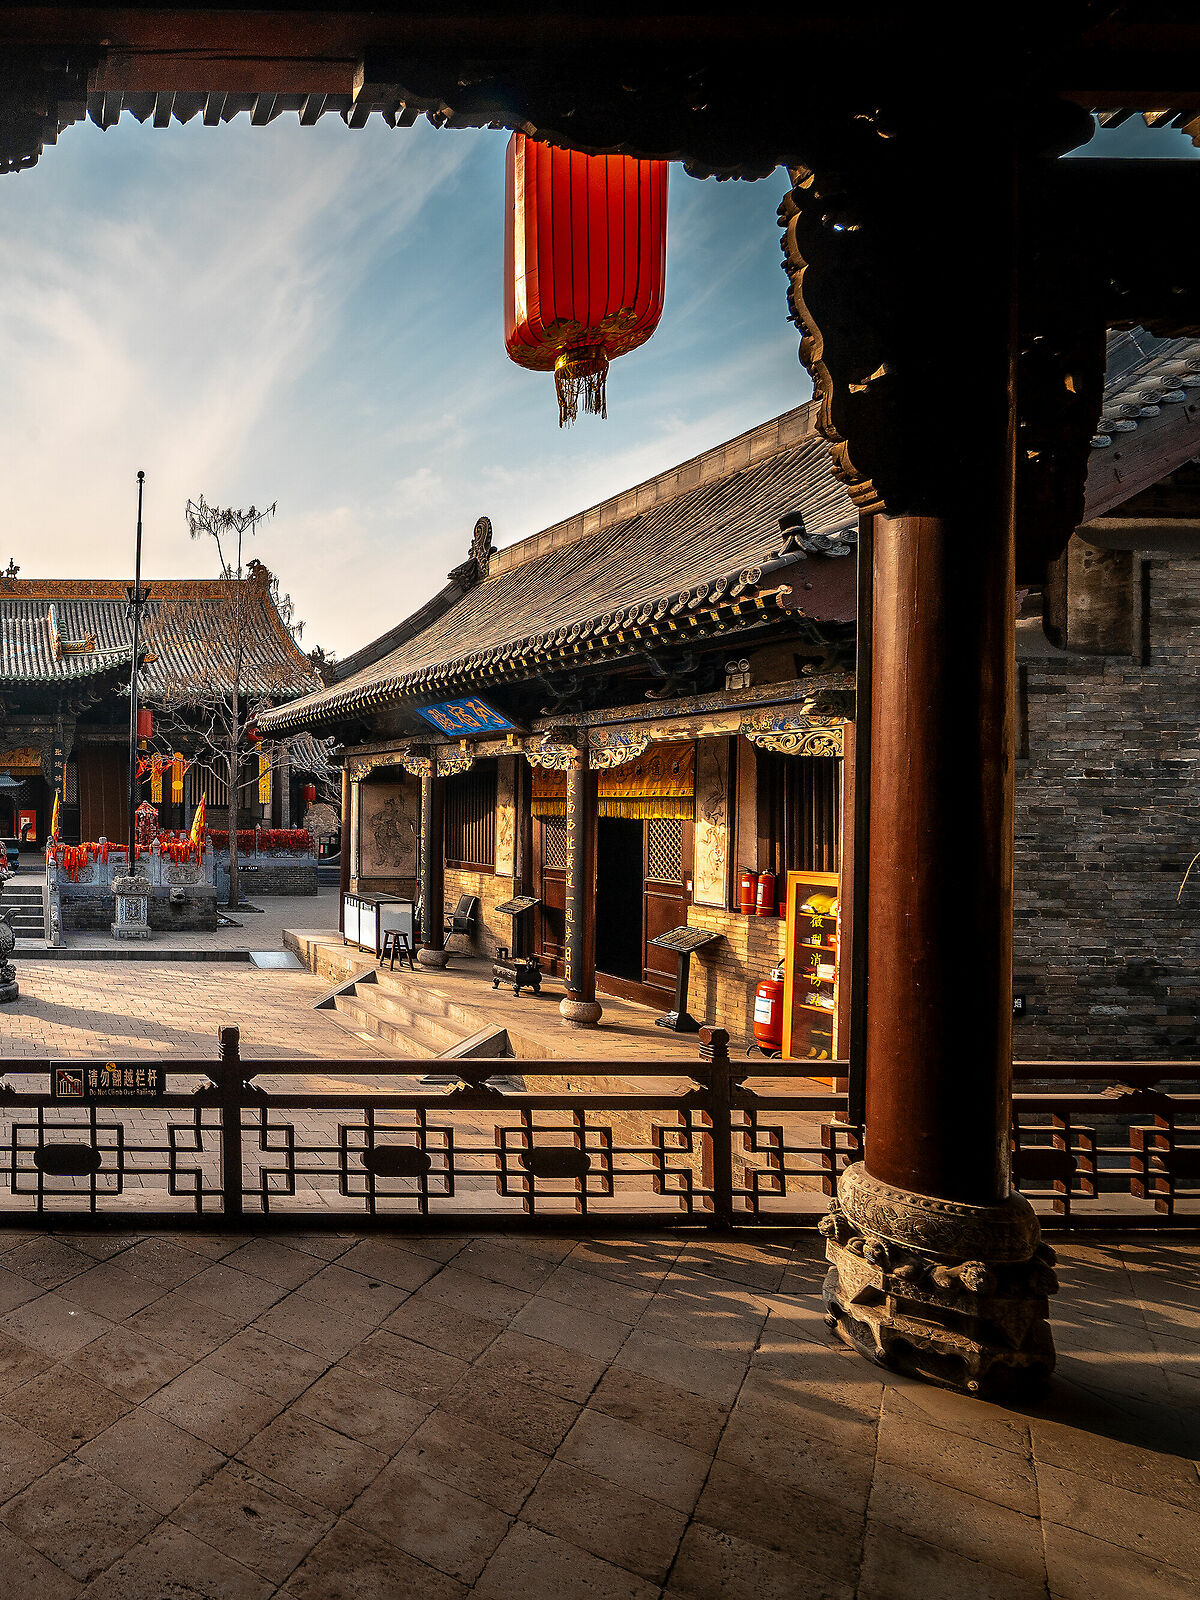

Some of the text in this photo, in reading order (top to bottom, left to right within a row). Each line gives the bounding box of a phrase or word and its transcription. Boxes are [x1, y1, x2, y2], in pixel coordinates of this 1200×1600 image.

[810, 915, 824, 1007] 微型消防站
[87, 1069, 158, 1087] 请勿翻越栏杆
